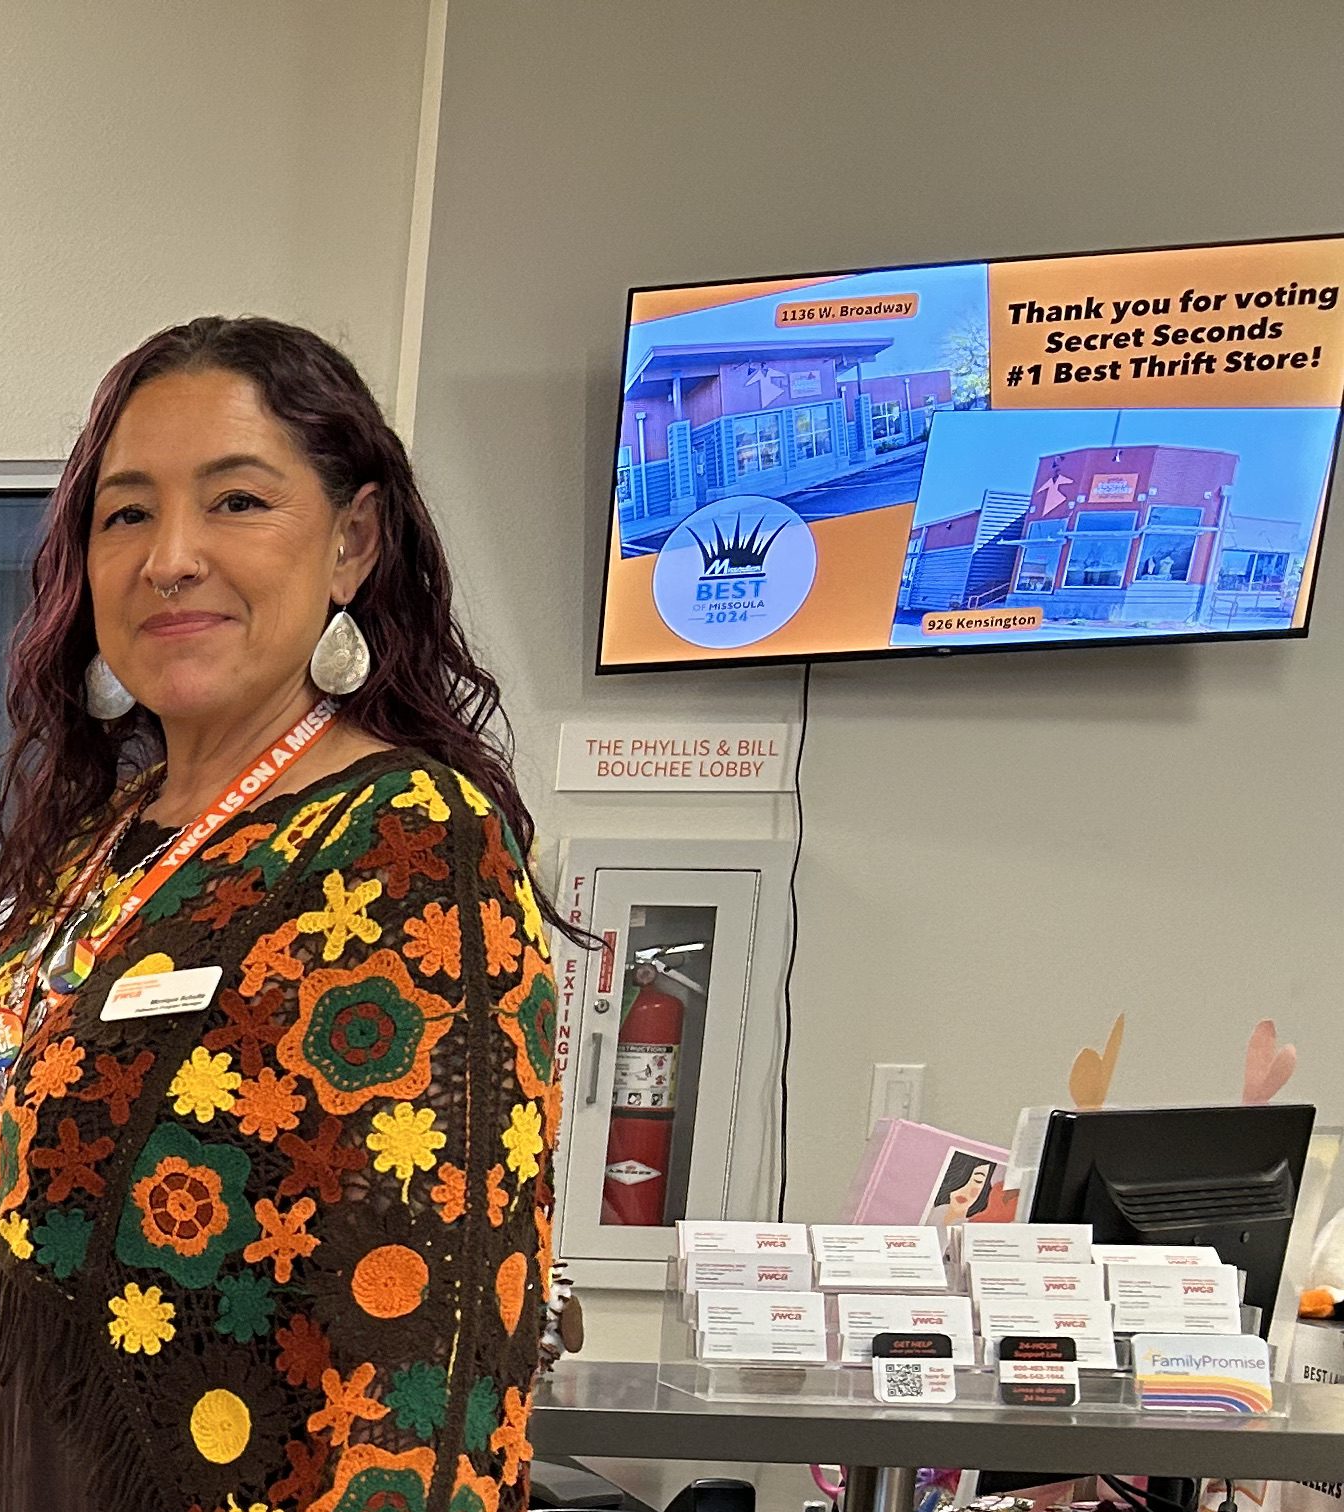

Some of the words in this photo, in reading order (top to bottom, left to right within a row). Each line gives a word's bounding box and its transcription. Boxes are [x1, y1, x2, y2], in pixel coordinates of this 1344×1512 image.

[1007, 296, 1105, 325] Thank
[1110, 297, 1171, 324] you
[1179, 288, 1228, 314] for
[1234, 281, 1340, 311] voting
[781, 308, 816, 322] 1136
[818, 306, 836, 319] W.
[839, 302, 913, 317] Broadway
[1044, 327, 1145, 354] Secret
[1151, 316, 1284, 347] Seconds
[1006, 364, 1042, 387] #1
[1053, 360, 1122, 384] Best
[1128, 351, 1218, 379] Thrift
[1223, 346, 1322, 373] Store!
[696, 580, 767, 601] BEST
[692, 604, 706, 612] OF
[708, 600, 765, 611] MISSOULA
[704, 610, 749, 624] 2024
[927, 619, 953, 631] 926
[956, 615, 1036, 630] Kensington
[585, 739, 625, 756] THE
[630, 739, 711, 757] PHYLLIS
[715, 739, 731, 757] &
[737, 739, 780, 757] BILL
[597, 760, 693, 777] BOUCHEE
[699, 760, 765, 777] LOBBY
[161, 813, 226, 868] YWCA
[218, 791, 245, 813] IS
[240, 762, 276, 794] ON
[271, 747, 294, 769] A
[284, 696, 341, 752] MISSI
[553, 959, 577, 1153] EXTINGUR
[1037, 1243, 1069, 1253] ywca
[757, 1271, 789, 1282] ywca
[1044, 1281, 1076, 1292] ywca
[1182, 1284, 1214, 1294] ywca
[770, 1311, 802, 1322] ywca
[911, 1316, 944, 1326] ywca
[1054, 1319, 1087, 1329] ywca
[892, 1340, 910, 1348] GET
[911, 1340, 933, 1348] HELP
[1151, 1354, 1266, 1370] FamilyPromise
[1303, 1365, 1328, 1384] BEST
